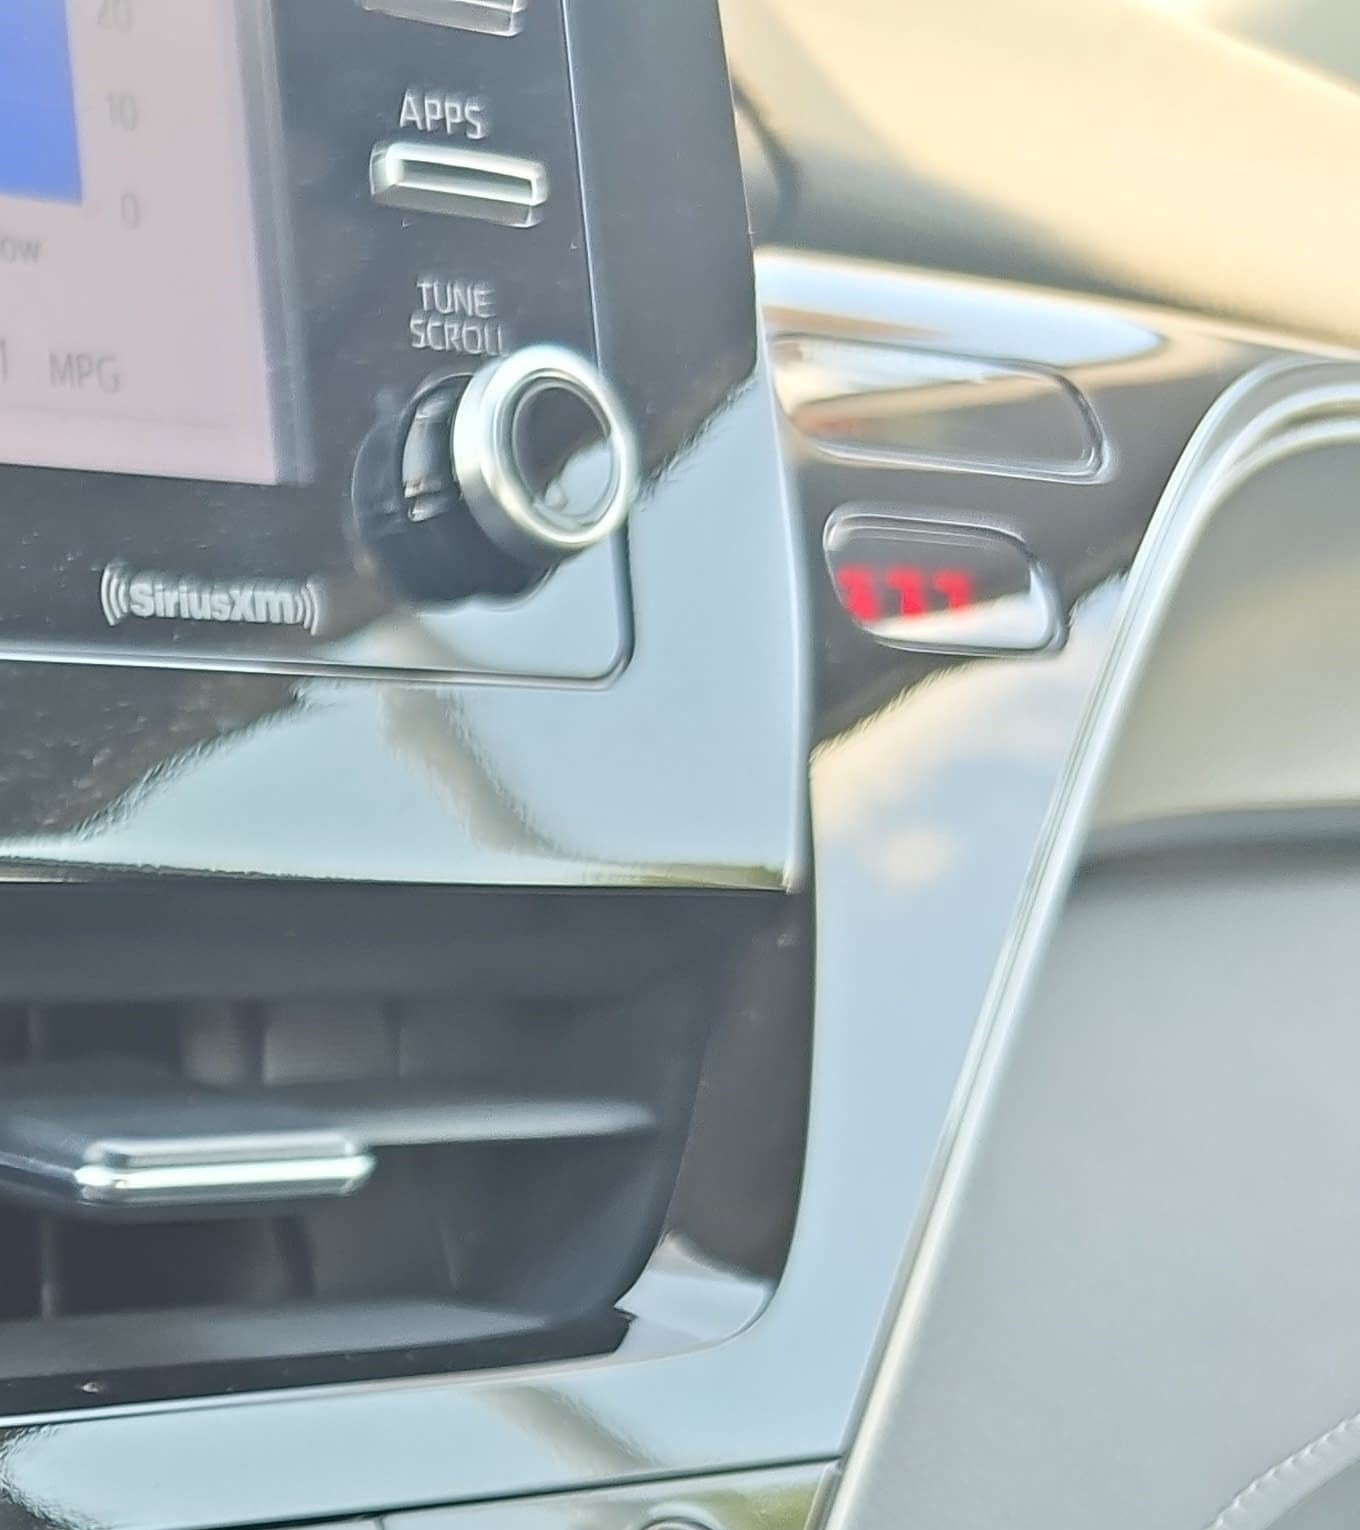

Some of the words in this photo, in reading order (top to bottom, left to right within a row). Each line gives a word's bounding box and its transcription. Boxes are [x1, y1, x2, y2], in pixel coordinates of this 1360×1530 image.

[398, 88, 486, 139] APPS
[416, 280, 495, 318] TUNE
[47, 351, 122, 393] MPG
